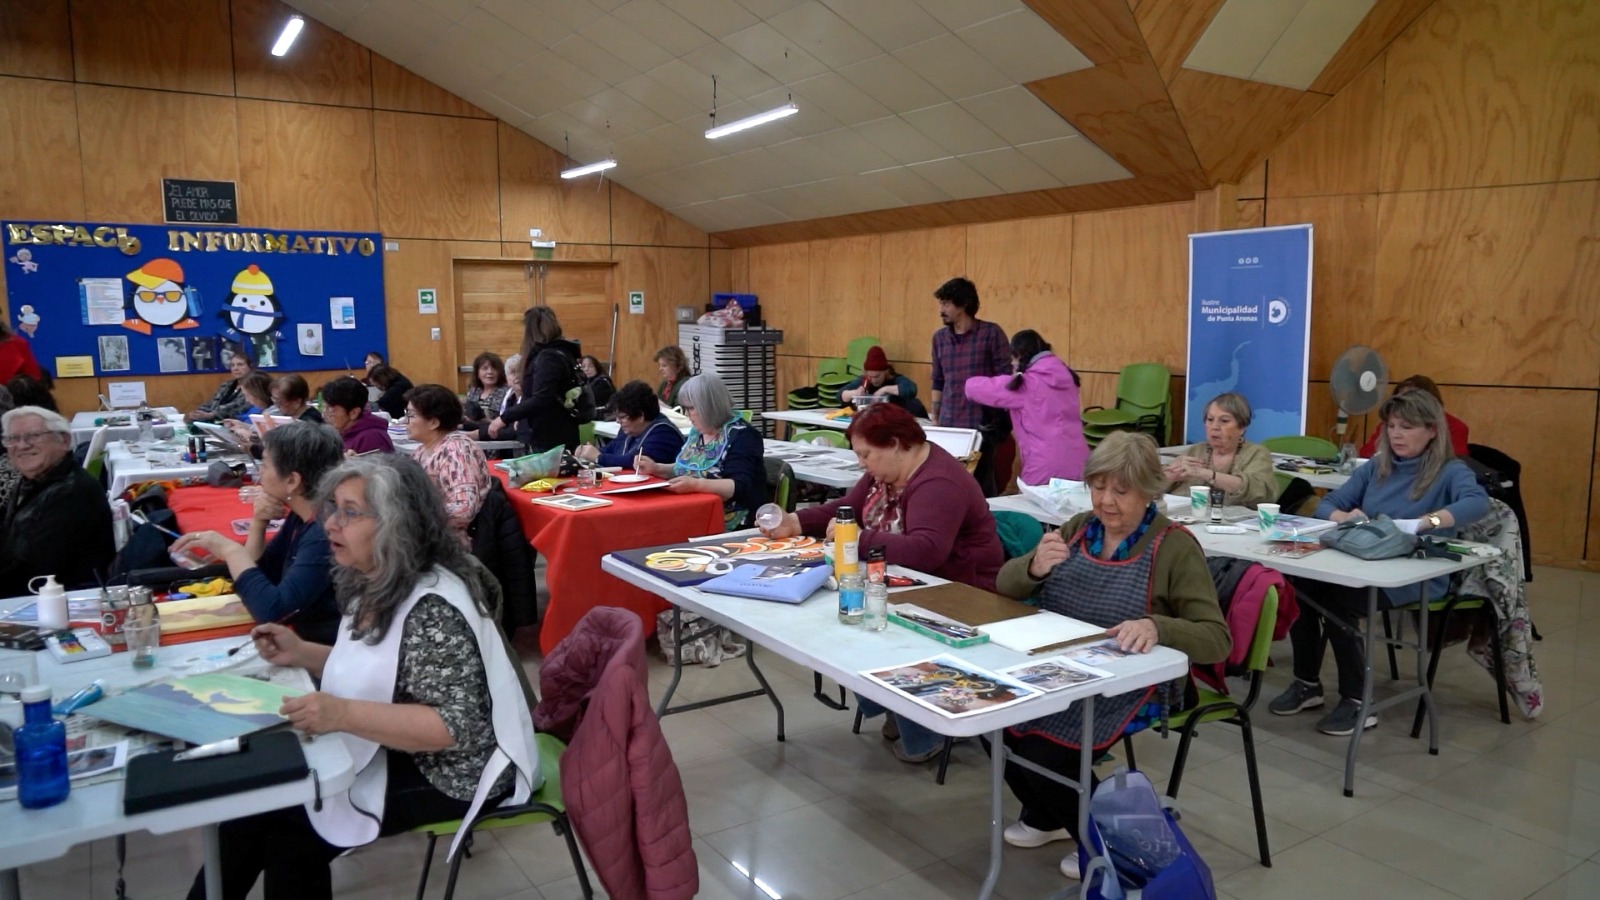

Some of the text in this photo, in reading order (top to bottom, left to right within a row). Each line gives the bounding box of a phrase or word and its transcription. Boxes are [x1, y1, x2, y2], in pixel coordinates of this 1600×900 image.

[6, 223, 376, 257] ESPACIO INFORMATIVO
[1201, 305, 1259, 315] Municipalidad
